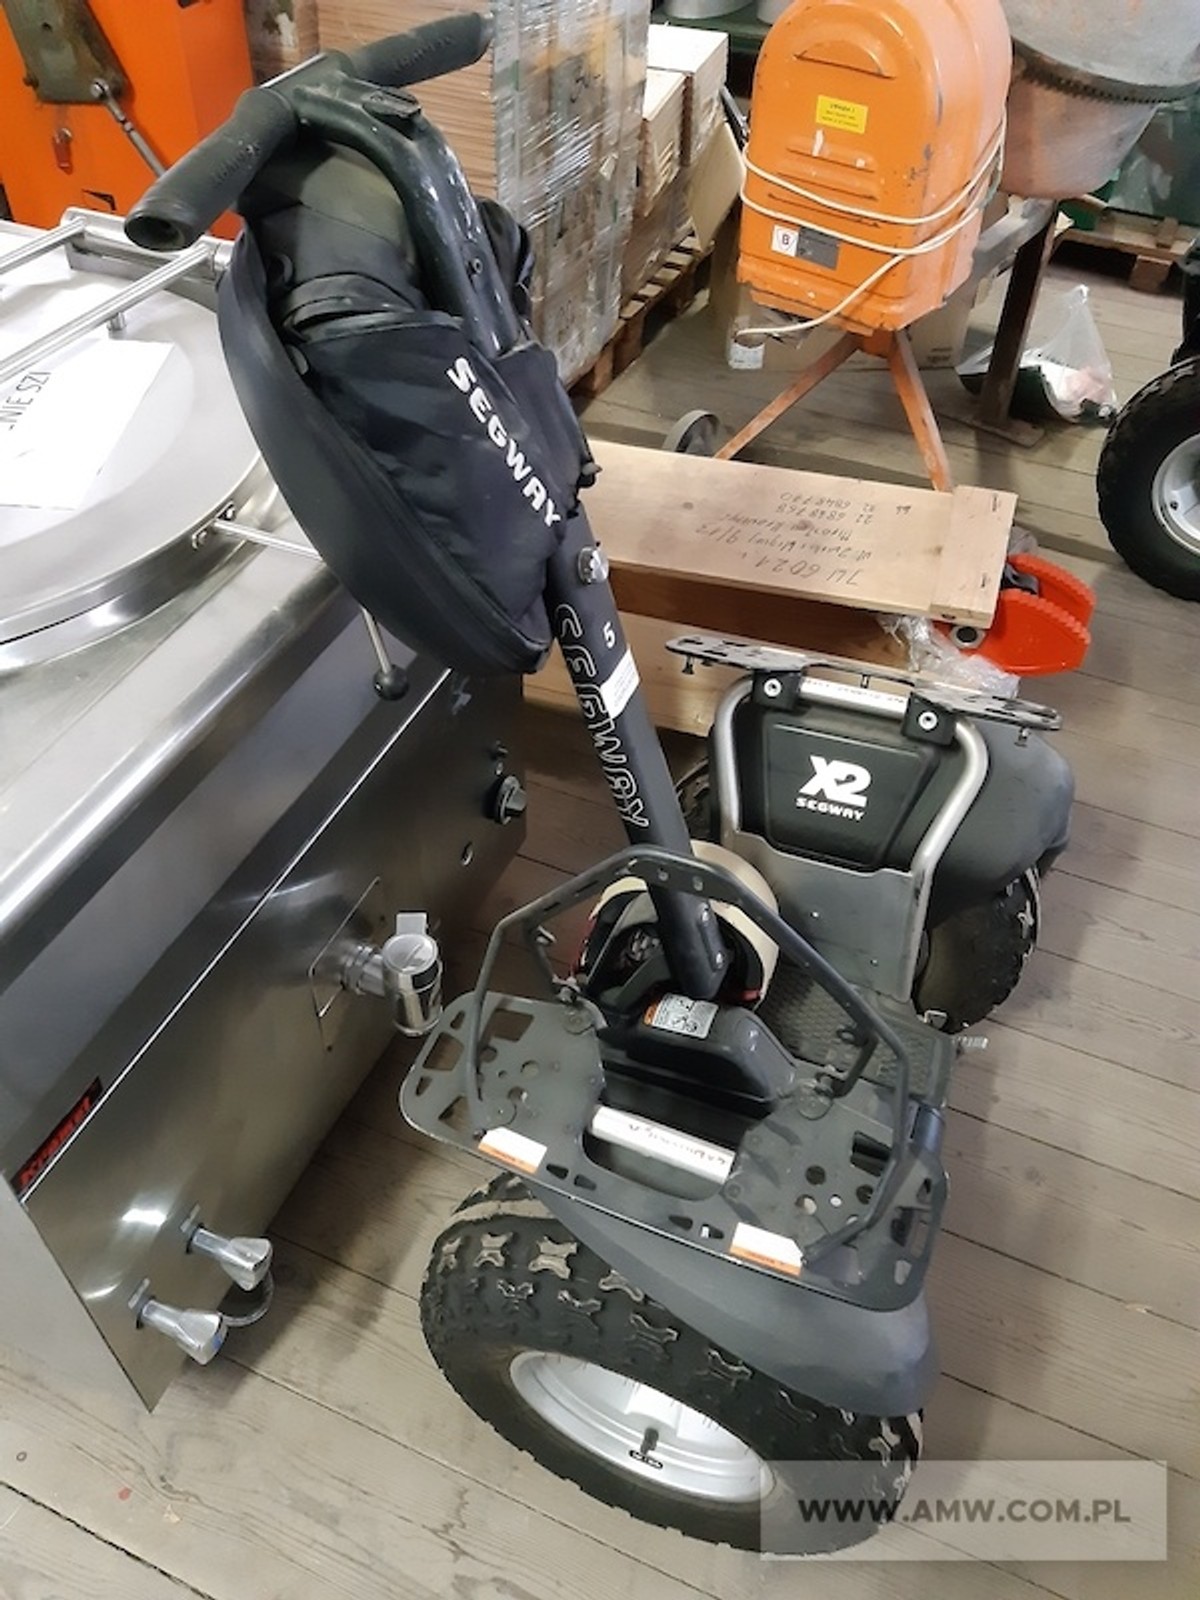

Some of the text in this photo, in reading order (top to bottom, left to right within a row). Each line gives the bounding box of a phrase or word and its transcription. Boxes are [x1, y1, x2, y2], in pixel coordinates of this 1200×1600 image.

[446, 357, 561, 527] SEGWAY
[603, 621, 616, 649] 5
[555, 603, 649, 828] SEGWAY
[798, 754, 872, 808] X2
[796, 797, 865, 821] SEGWAY
